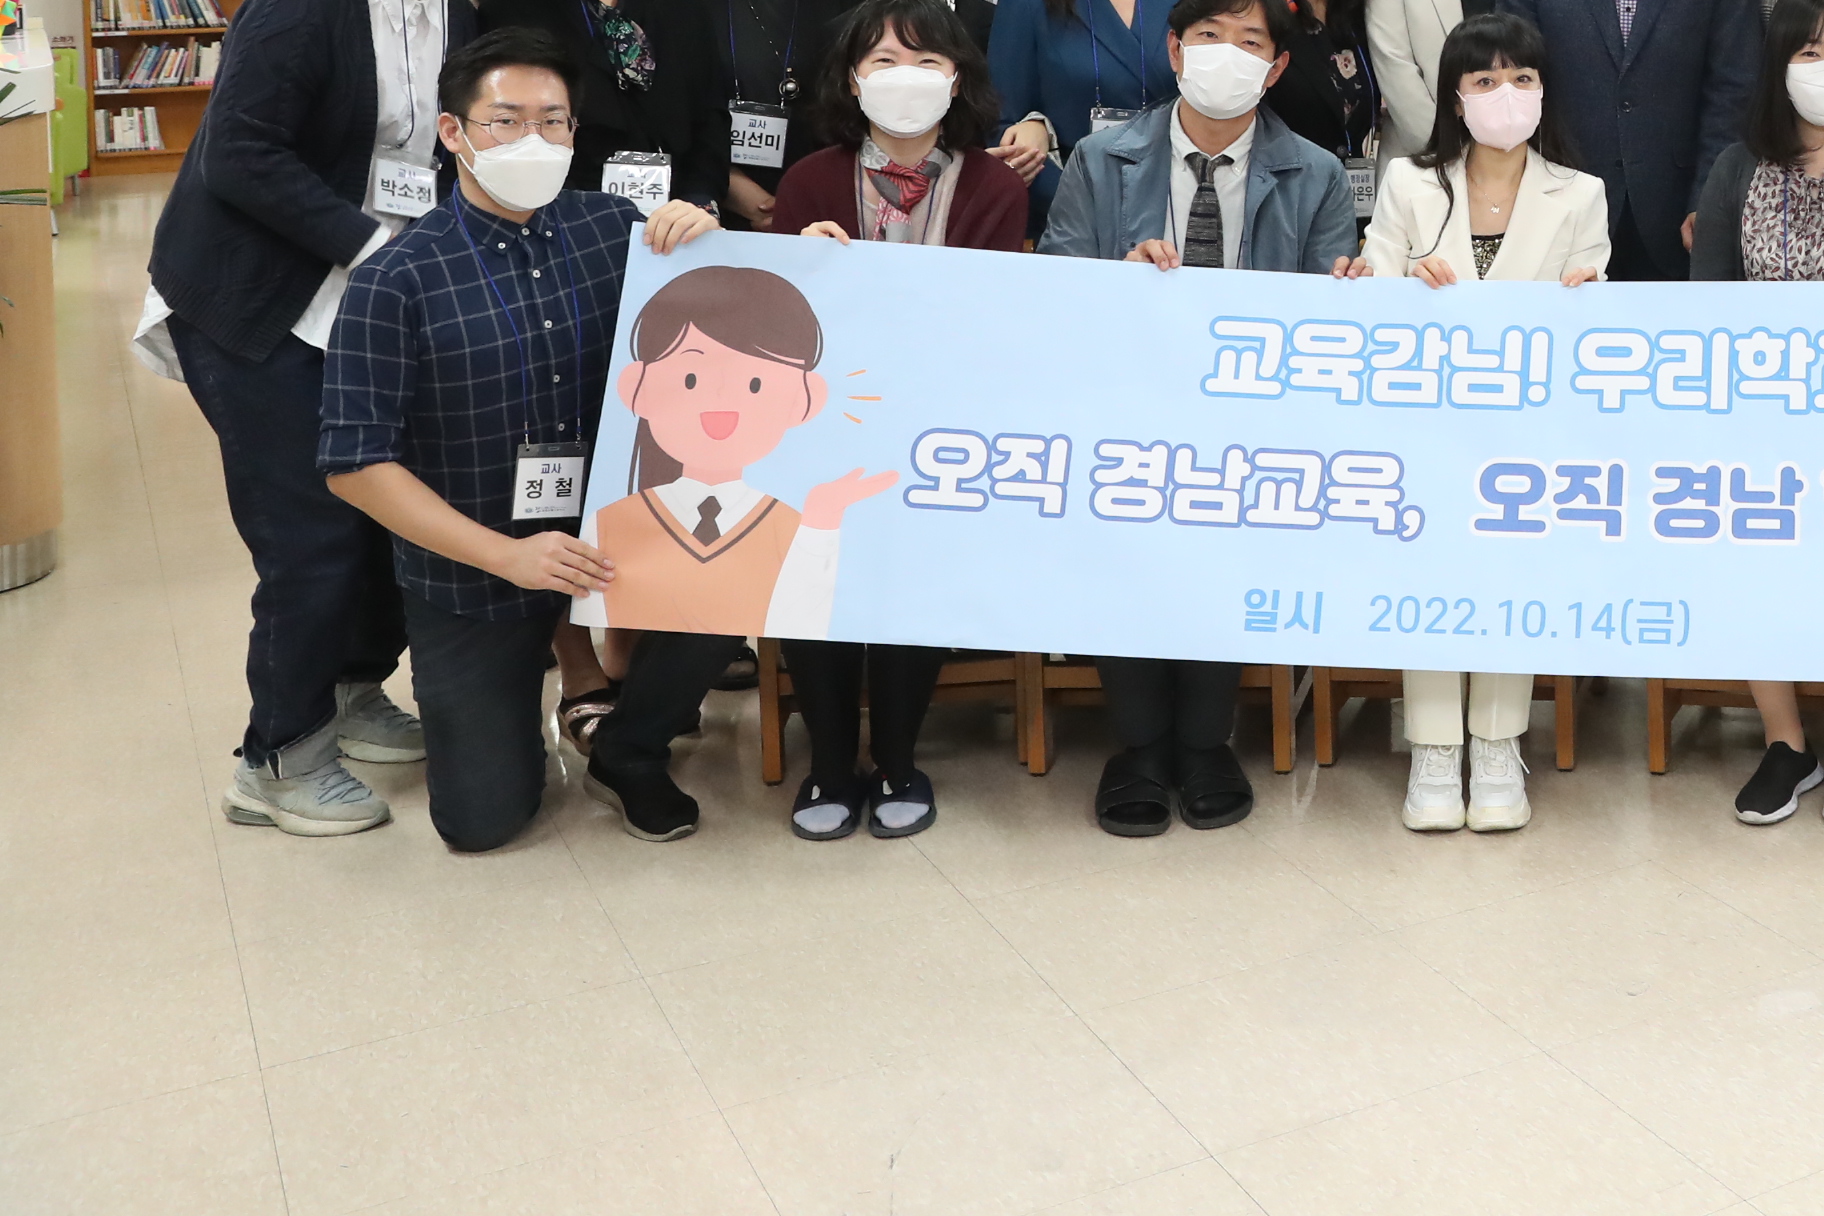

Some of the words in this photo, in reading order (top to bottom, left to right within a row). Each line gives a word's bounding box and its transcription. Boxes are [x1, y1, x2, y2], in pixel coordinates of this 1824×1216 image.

[748, 119, 767, 129] 교사
[731, 130, 780, 151] 임선미
[1350, 174, 1370, 183] 행정실장
[381, 178, 431, 204] 박소정
[609, 182, 663, 200] 이현주
[1201, 316, 1553, 412] 교육감님!
[541, 463, 562, 474] 교사
[525, 478, 543, 499] 정
[555, 477, 573, 498] 철
[903, 428, 1072, 518] 오직
[1089, 438, 1425, 541] 경남교육,
[1469, 457, 1627, 543] 오직
[1648, 458, 1806, 546] 경남
[1242, 588, 1323, 636] 일시
[1369, 595, 1691, 647] 2022.10.14(금)
